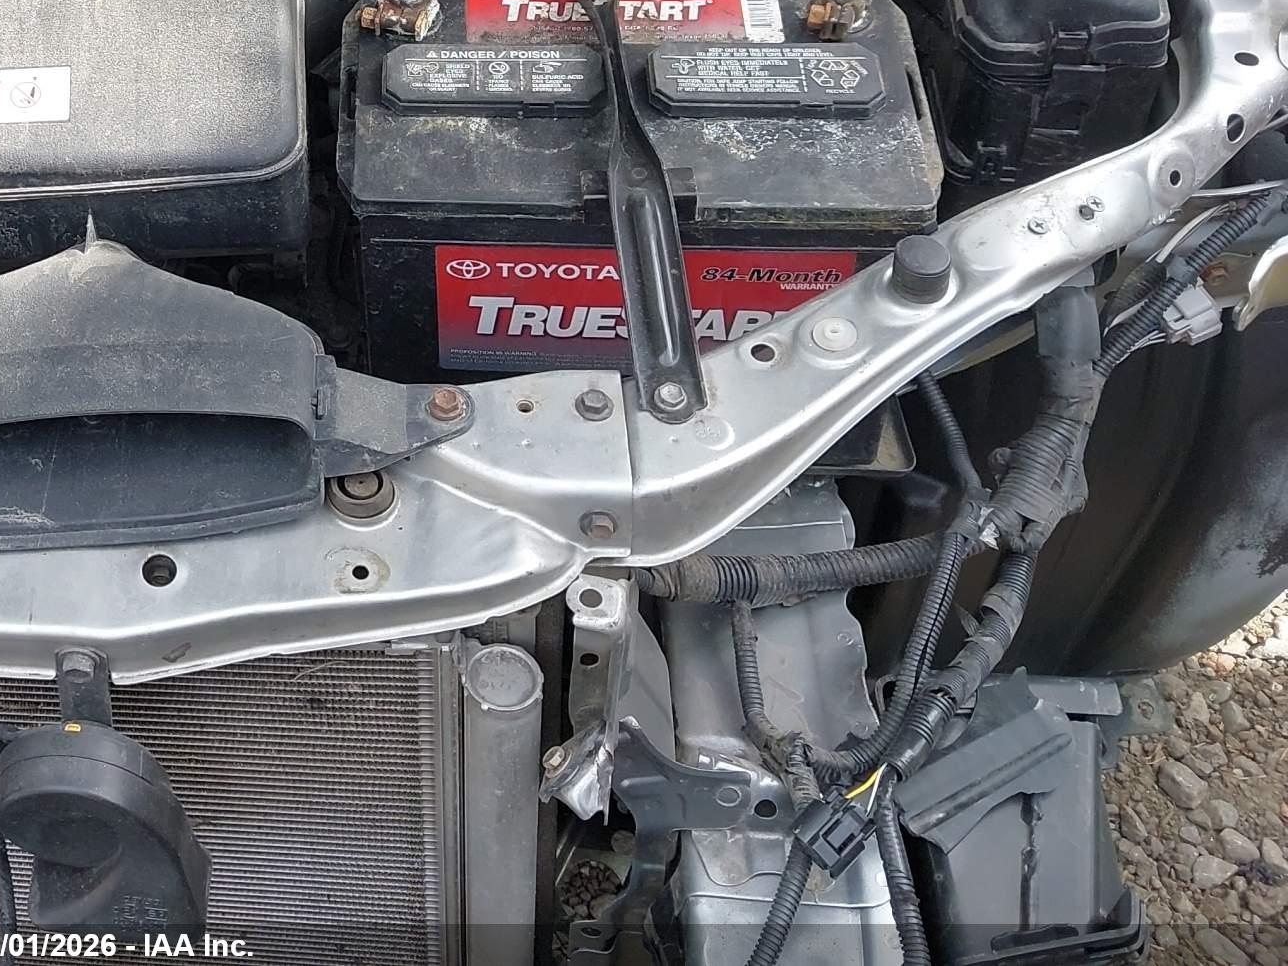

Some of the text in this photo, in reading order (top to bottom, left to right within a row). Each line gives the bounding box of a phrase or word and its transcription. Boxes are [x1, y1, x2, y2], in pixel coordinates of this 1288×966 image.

[441, 51, 495, 59] DANGER
[510, 51, 560, 59] POISON
[496, 262, 620, 280] TOYOTA
[700, 266, 841, 283] 84-Month
